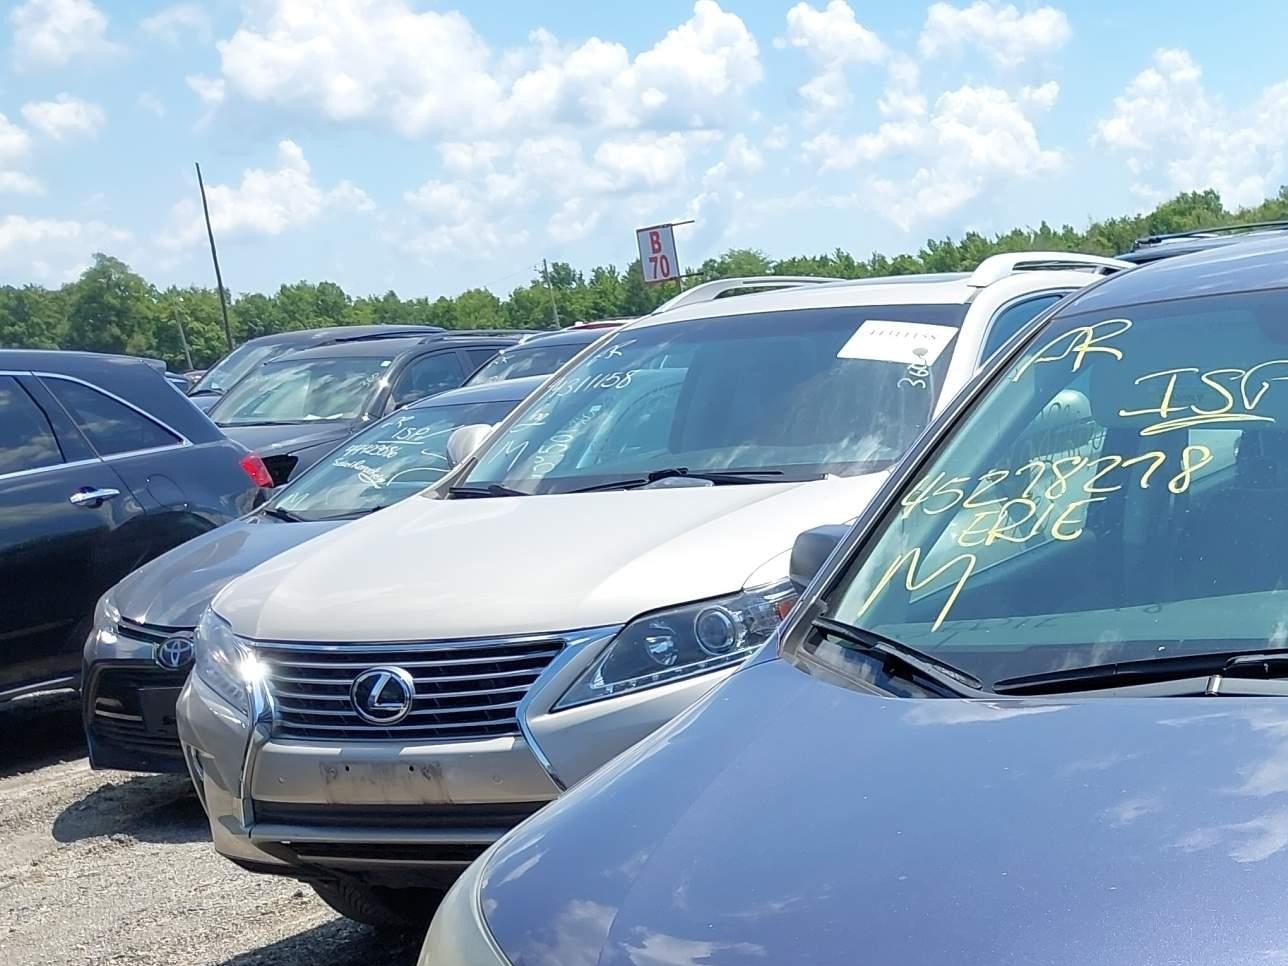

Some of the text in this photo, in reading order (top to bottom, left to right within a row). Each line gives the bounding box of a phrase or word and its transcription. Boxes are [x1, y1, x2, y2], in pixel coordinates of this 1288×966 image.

[649, 231, 661, 254] B
[649, 254, 670, 279] 70
[901, 445, 1214, 520] 45278278
[957, 497, 1108, 547] ERIE
